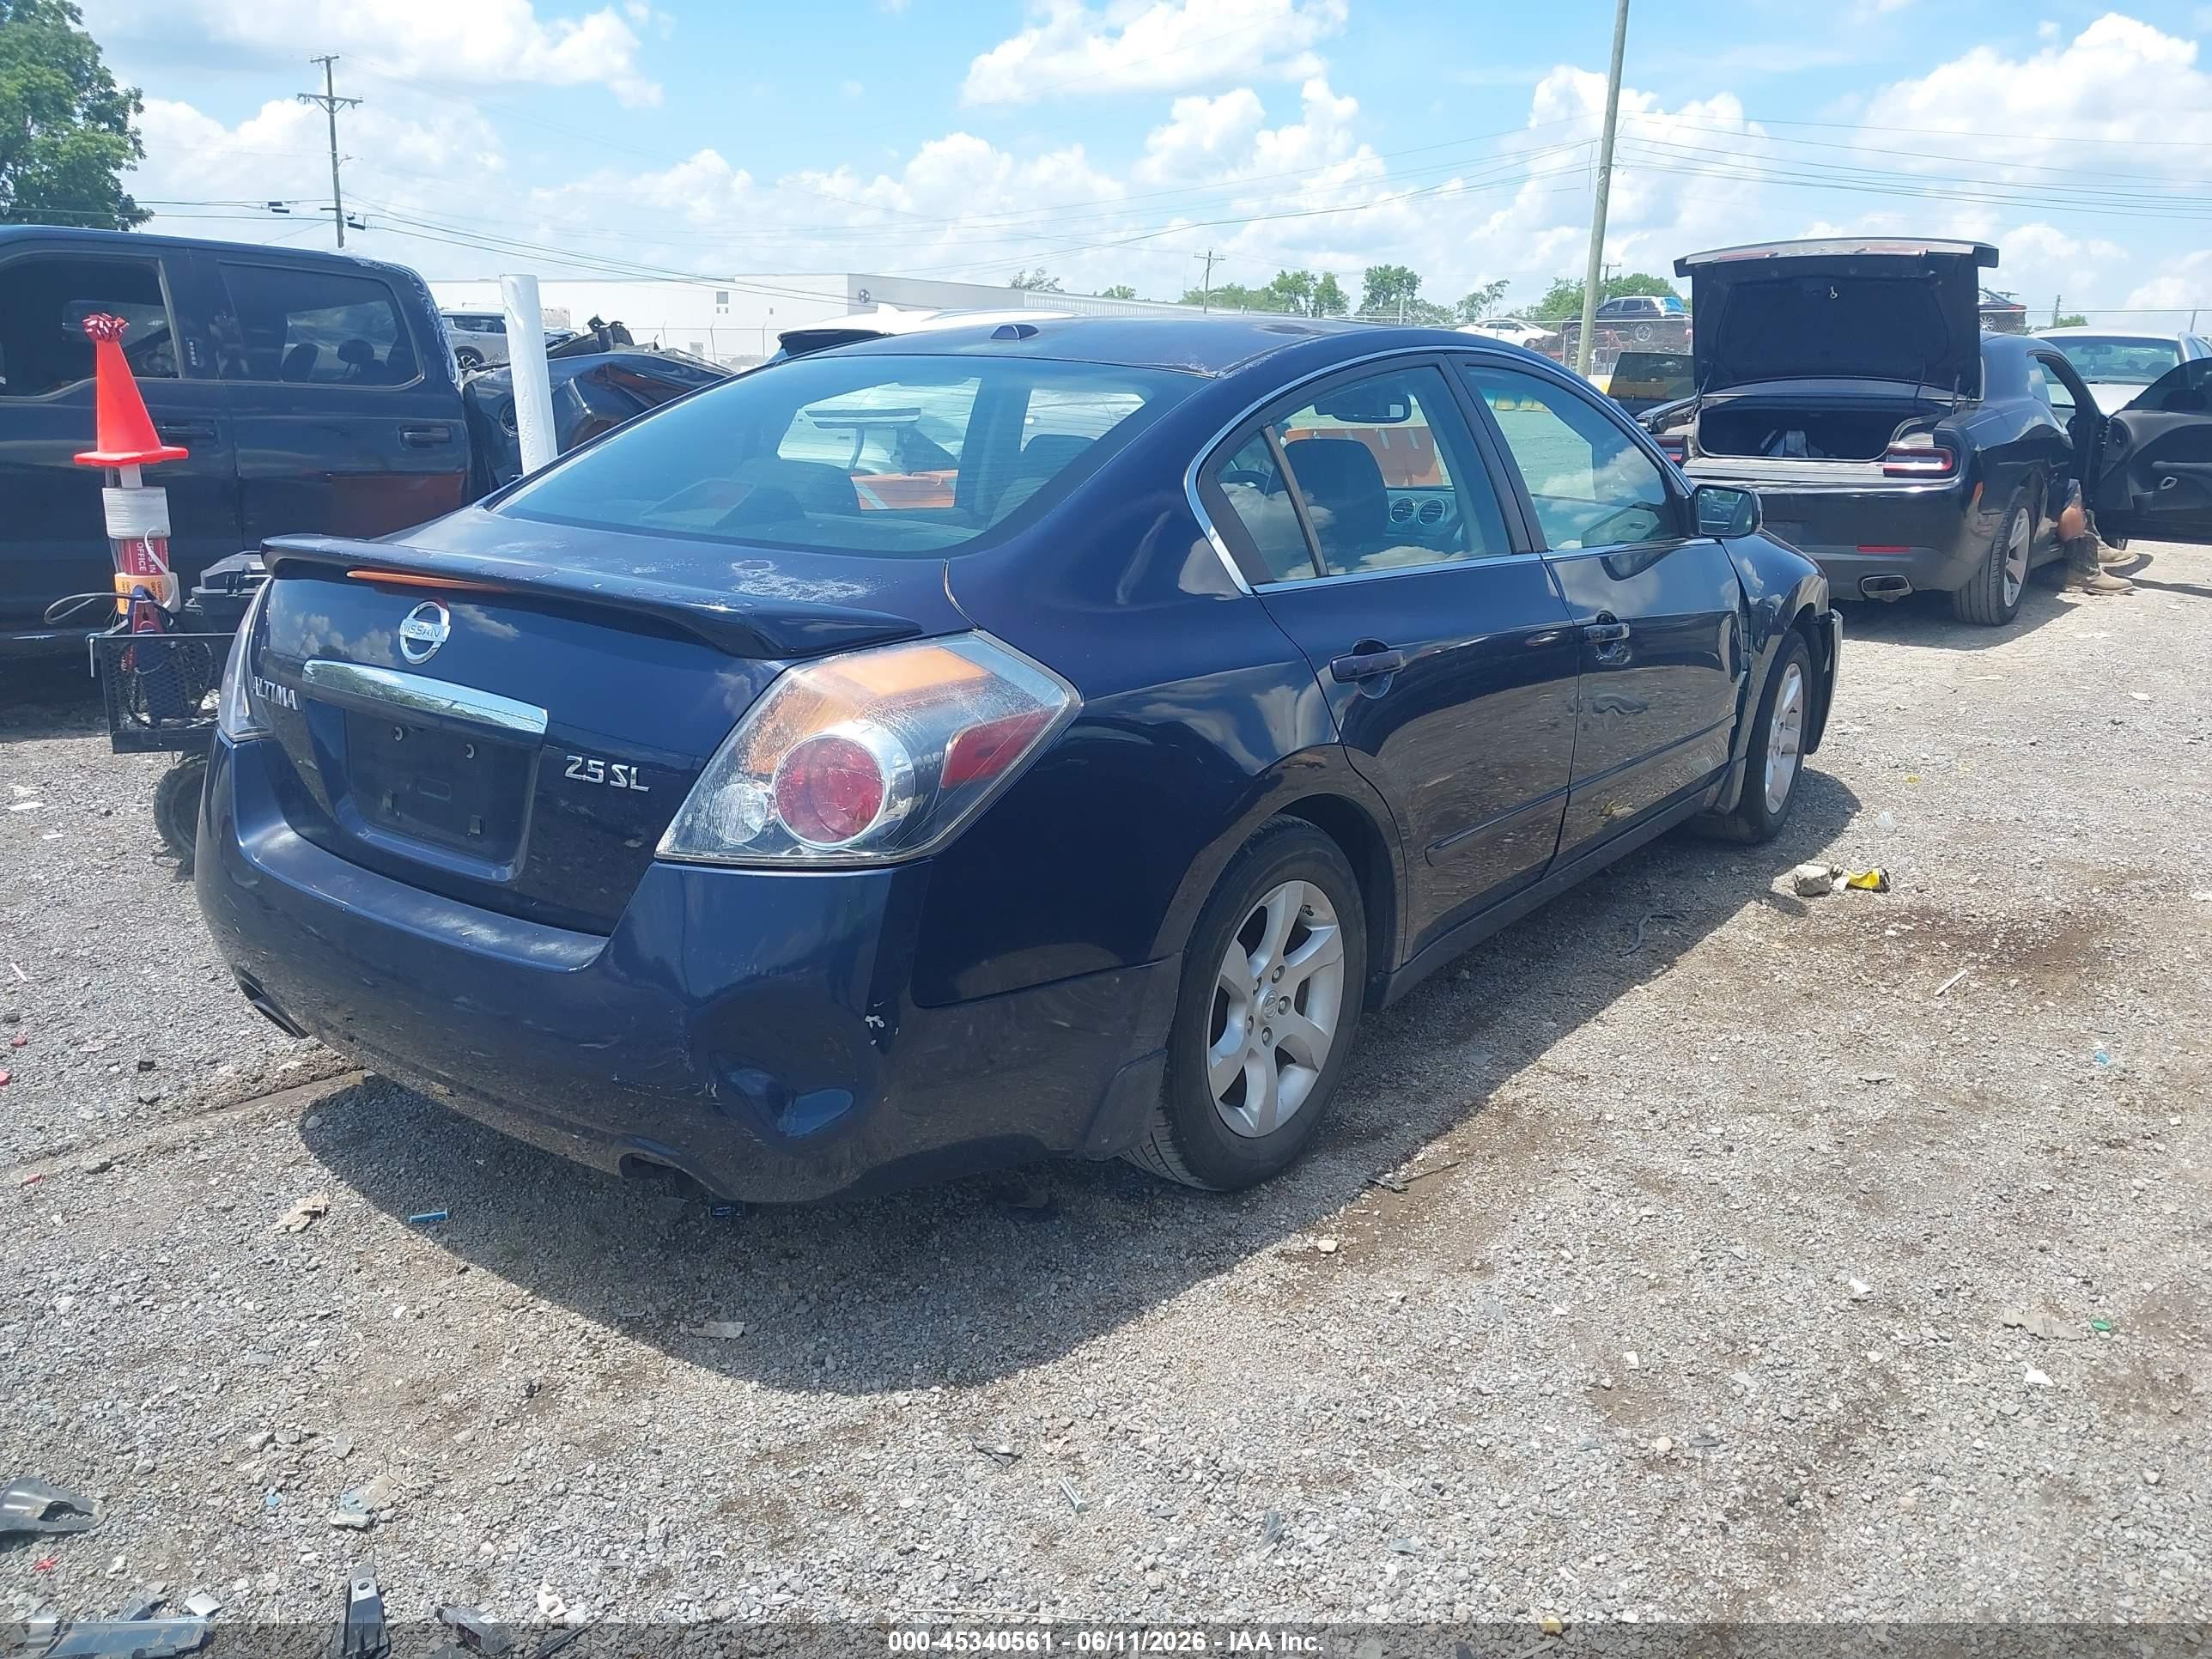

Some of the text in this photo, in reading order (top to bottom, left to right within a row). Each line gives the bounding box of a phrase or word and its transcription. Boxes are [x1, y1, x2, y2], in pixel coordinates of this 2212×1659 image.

[137, 542, 147, 572] OFFICE
[149, 564, 156, 574] IN
[402, 623, 441, 639] NISSAN
[252, 676, 299, 711] ALTIMA
[610, 763, 650, 792] SL
